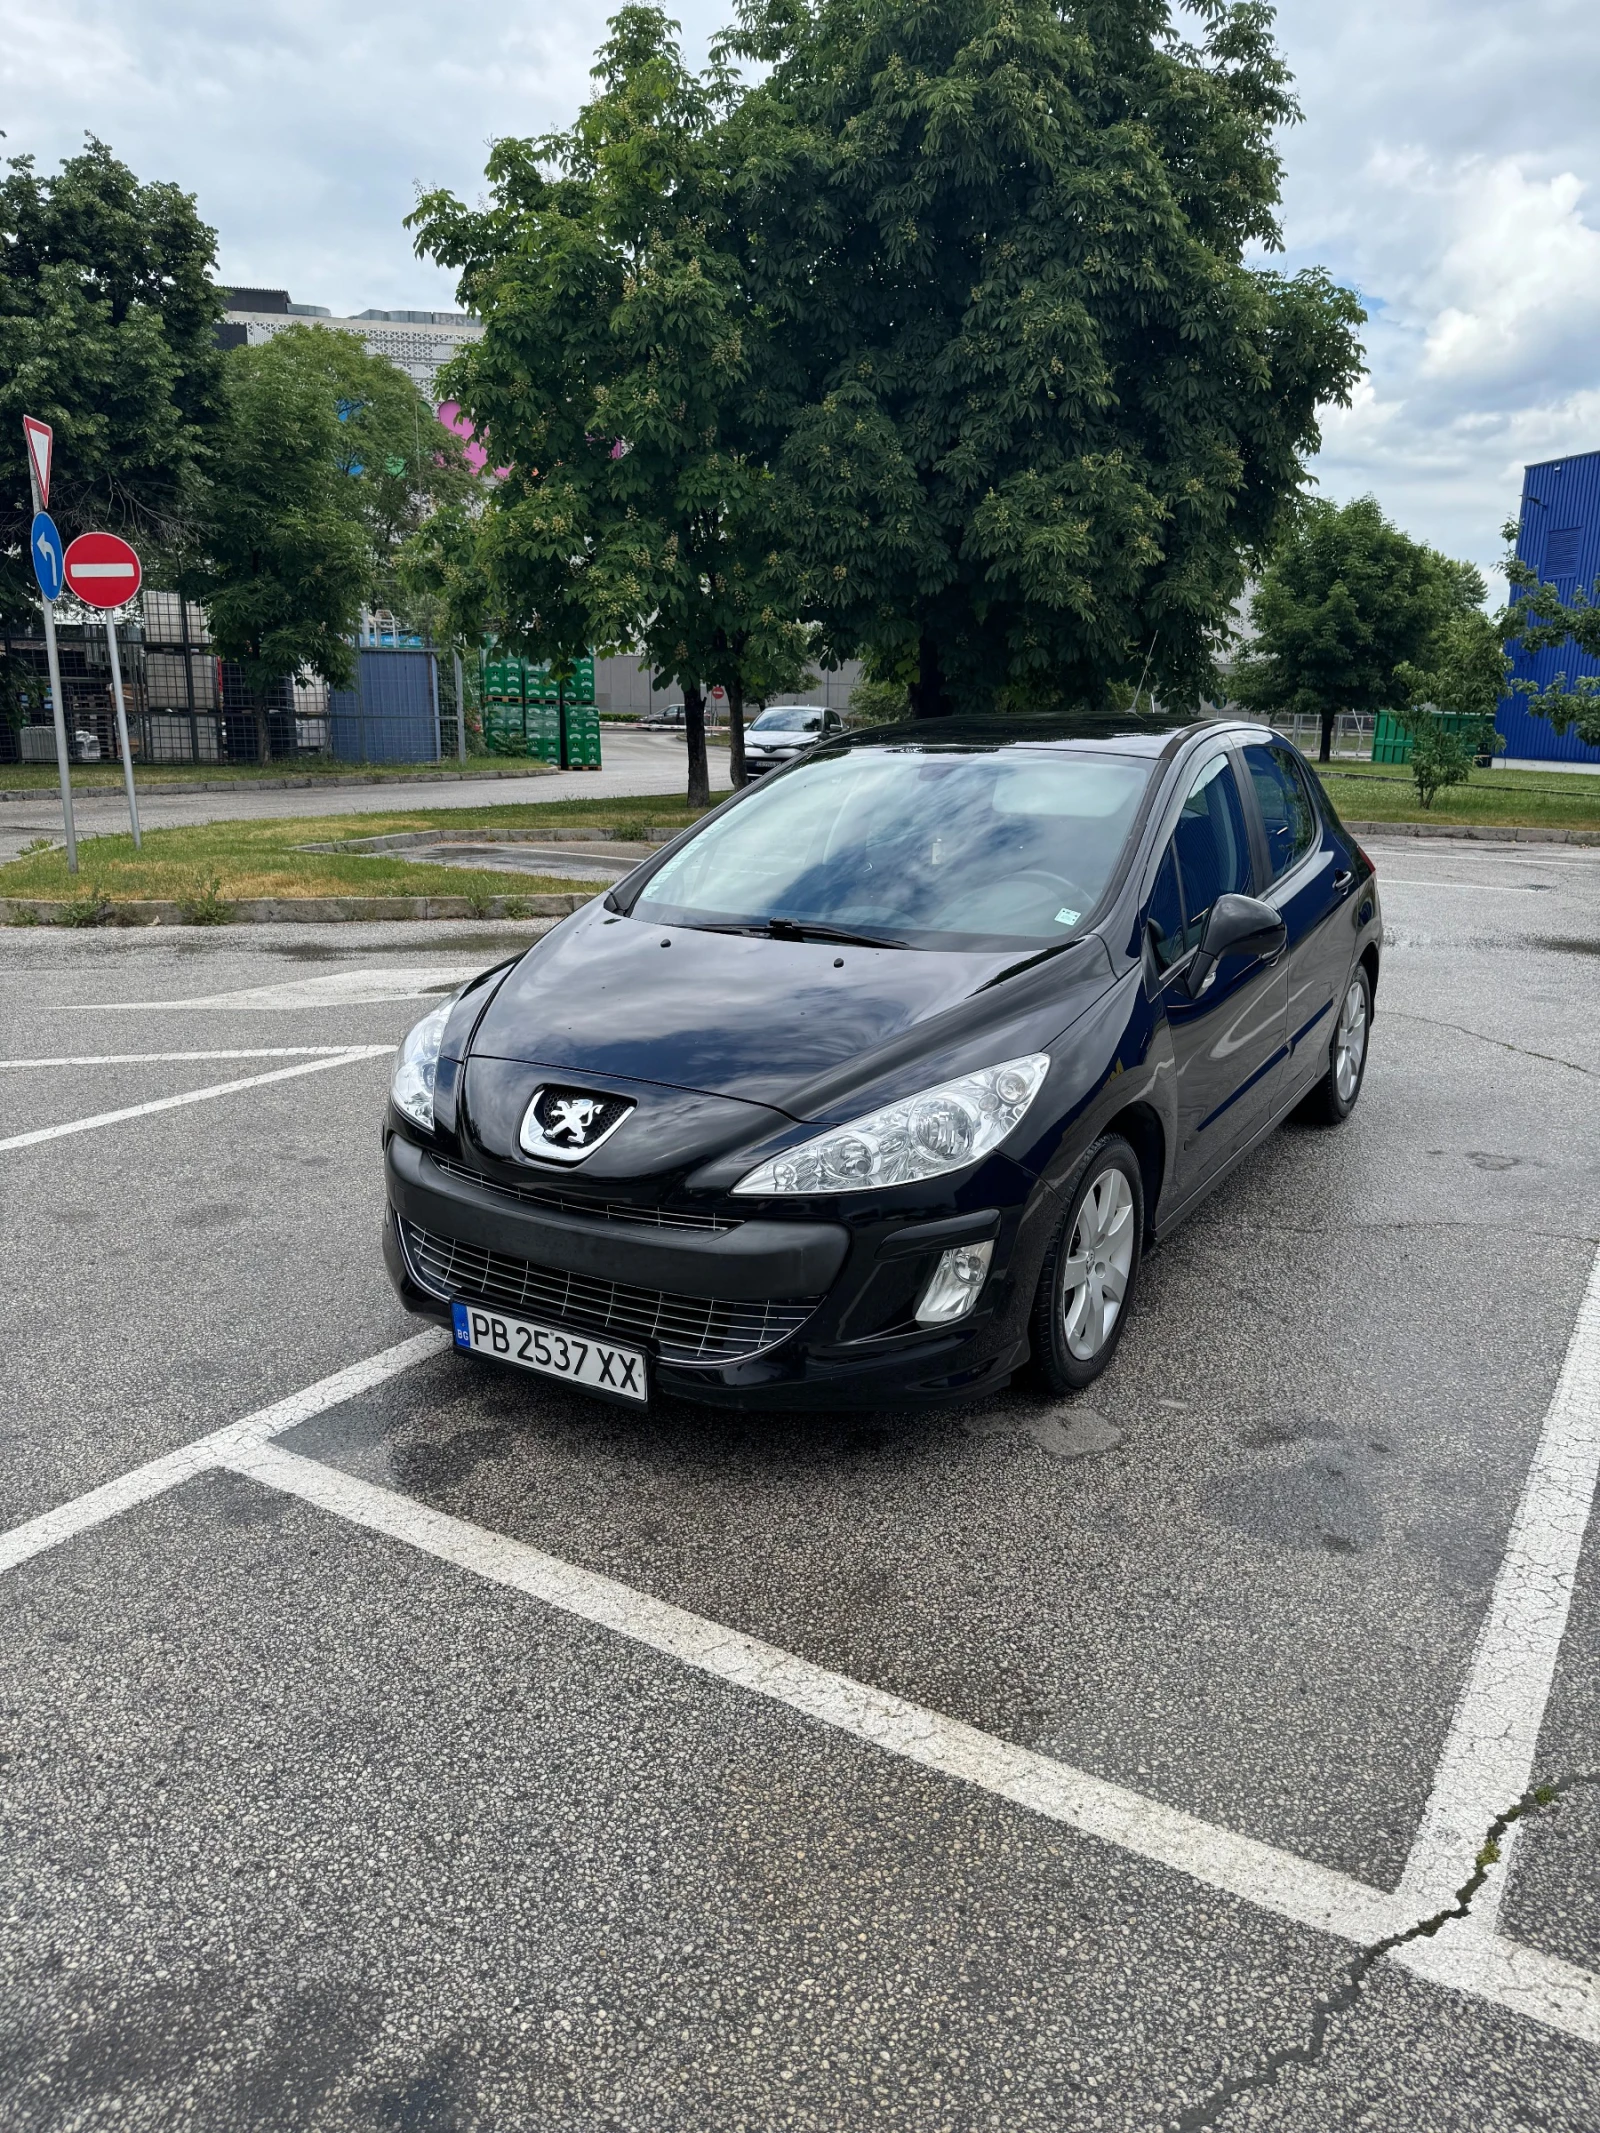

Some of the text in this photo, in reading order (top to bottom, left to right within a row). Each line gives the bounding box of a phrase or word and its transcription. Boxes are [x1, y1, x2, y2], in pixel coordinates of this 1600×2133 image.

[457, 1329, 469, 1341] BG
[472, 1312, 639, 1393] PB 2537 XX
